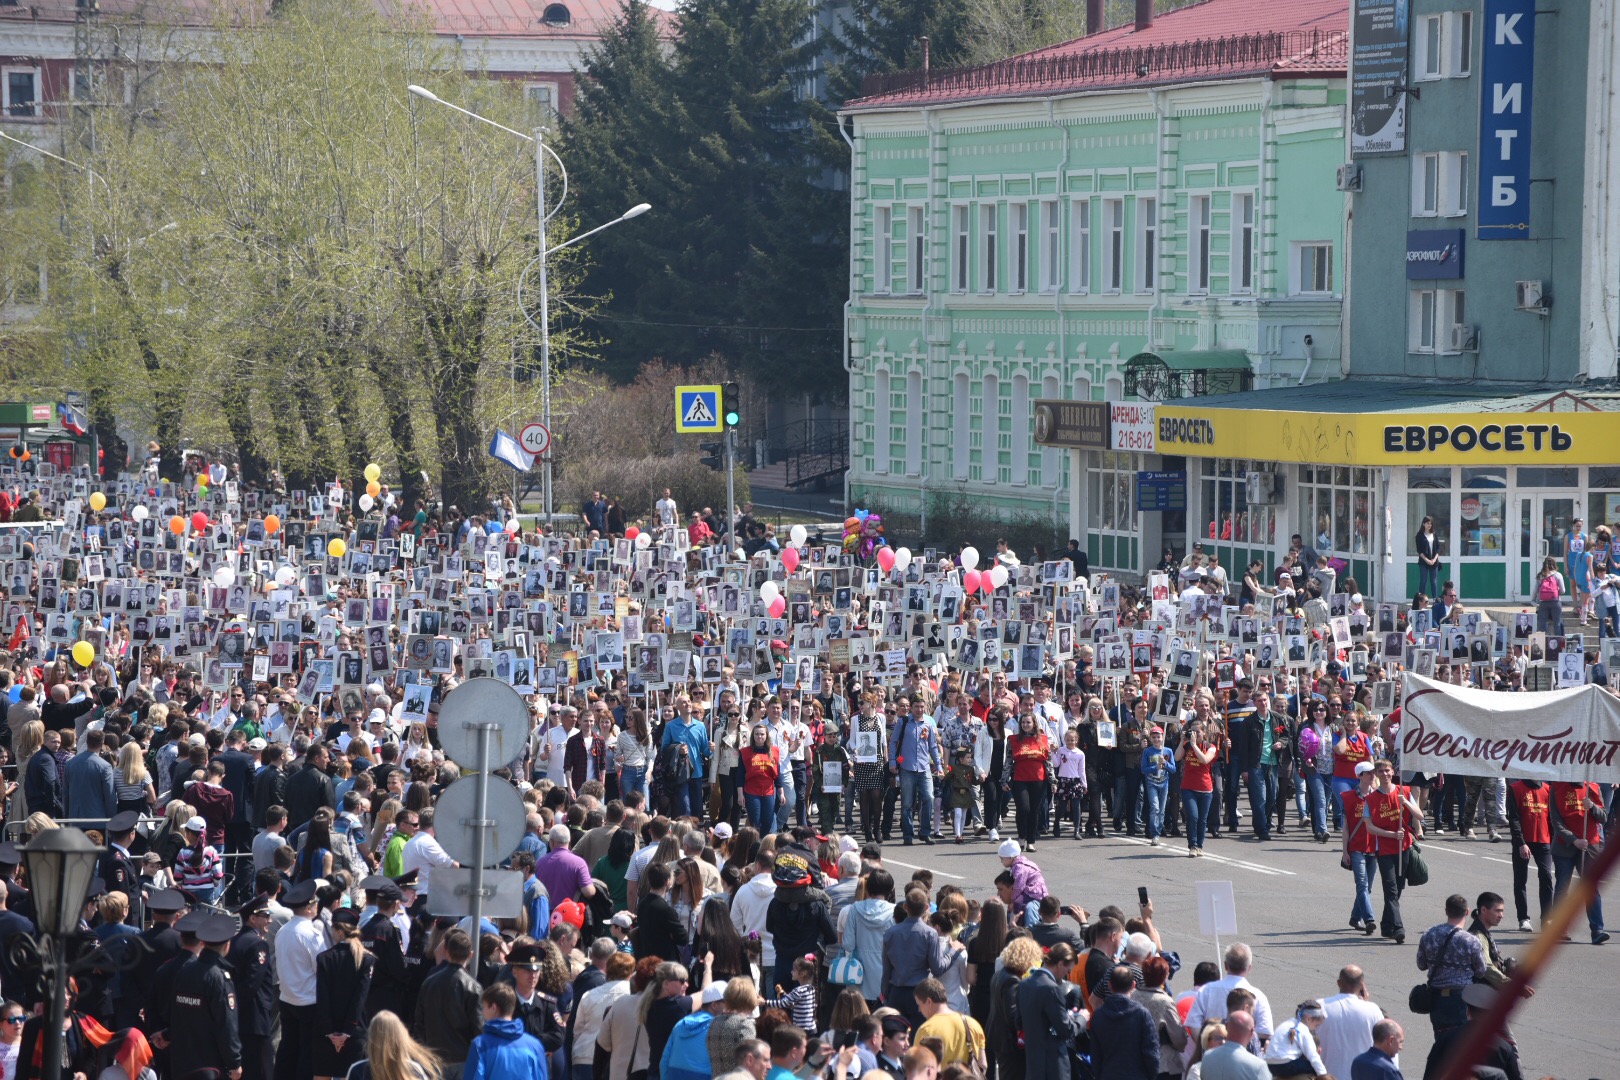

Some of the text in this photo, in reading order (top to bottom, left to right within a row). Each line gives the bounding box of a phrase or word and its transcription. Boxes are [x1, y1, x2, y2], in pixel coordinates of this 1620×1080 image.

[1398, 107, 1404, 128] 3
[1406, 250, 1441, 262] АЭРОФЛОТ
[1111, 406, 1140, 427] АРЕНДА
[525, 432, 543, 445] 40
[1118, 430, 1153, 449] 216-612
[1159, 416, 1215, 445] ЕВРОСЕТЬ
[1384, 424, 1573, 452] ЕВРОСЕТЬ
[1403, 688, 1620, 771] бессмертный
[176, 995, 201, 1006] ПОЛИЦИЯ
